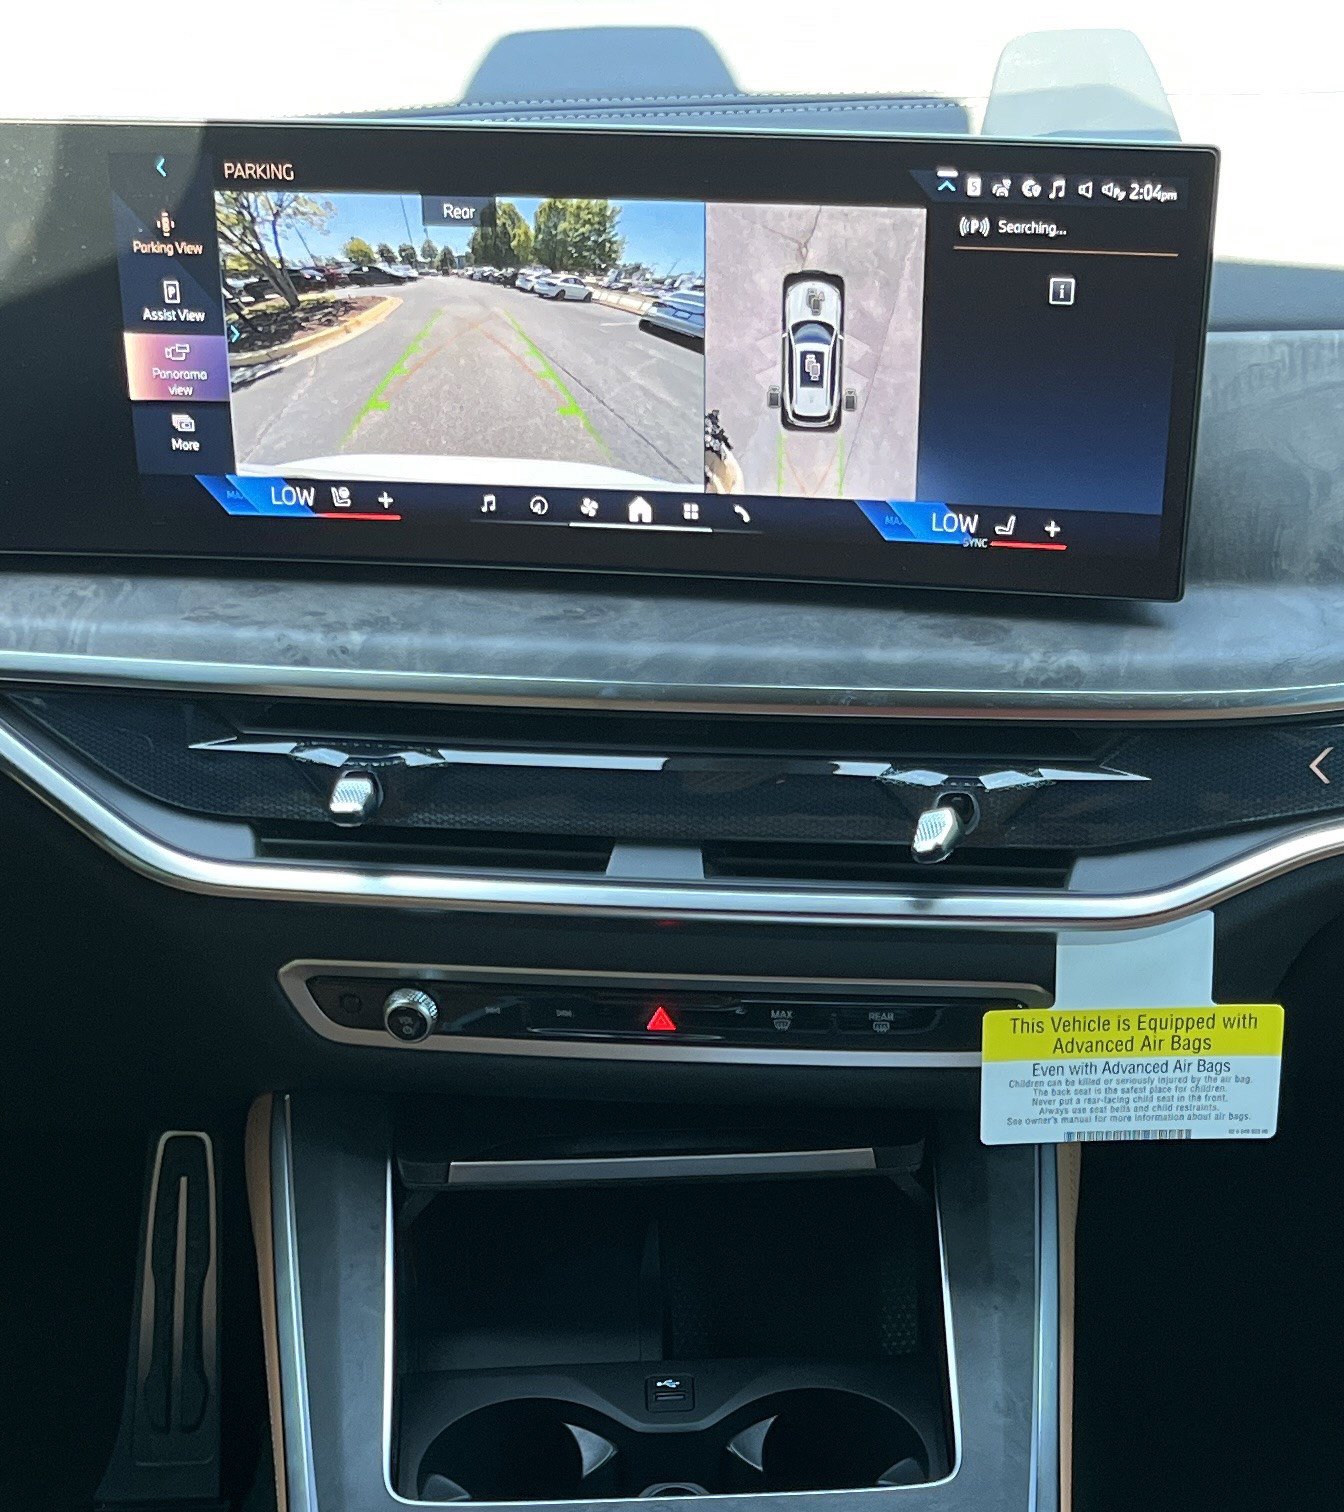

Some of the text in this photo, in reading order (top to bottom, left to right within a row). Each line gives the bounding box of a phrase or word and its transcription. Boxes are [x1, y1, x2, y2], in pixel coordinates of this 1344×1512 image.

[223, 162, 295, 181] PARKING
[1128, 182, 1178, 202] 2:04pm
[443, 203, 476, 219] Rear
[998, 219, 1067, 237] Searching...
[133, 240, 203, 257] Parking View
[143, 307, 206, 322] Assist View
[152, 367, 208, 381] Panorama
[168, 384, 193, 396] view
[171, 438, 200, 451] More
[271, 486, 315, 507] LOW
[931, 512, 979, 534] LOW
[962, 537, 988, 548] SYNC
[770, 1009, 794, 1019] MAX
[868, 1011, 895, 1021] REAR
[1010, 1012, 1258, 1034] This Vehicle is Equipped with
[1052, 1034, 1212, 1054] Advanced Air Bags
[1032, 1058, 1231, 1077] Even with Advanced Air Bags
[1009, 1079, 1044, 1088] Children
[1047, 1079, 1062, 1087] can
[1065, 1078, 1075, 1086] be
[1116, 1076, 1155, 1085] seriously
[1157, 1075, 1188, 1084] injured
[1191, 1075, 1201, 1084] by
[1204, 1075, 1217, 1083] the
[1220, 1075, 1231, 1083] air
[1033, 1088, 1048, 1096] The
[1051, 1088, 1071, 1096] back
[1074, 1087, 1092, 1095] seat
[1104, 1086, 1118, 1095] the
[1120, 1086, 1147, 1095] safest
[1149, 1085, 1171, 1094] place
[1175, 1084, 1187, 1093] for
[1032, 1098, 1056, 1106] Never
[1059, 1098, 1073, 1106] put
[1084, 1096, 1130, 1105] rear-facing
[1133, 1094, 1154, 1103] child
[1156, 1094, 1174, 1102] seat
[1188, 1094, 1202, 1102] the
[1039, 1107, 1069, 1116] Always
[1110, 1105, 1131, 1113] belts
[1152, 1104, 1173, 1112] child
[1007, 1117, 1022, 1126] See
[1061, 1115, 1091, 1123] manual
[1134, 1112, 1184, 1121] information
[1187, 1112, 1212, 1120] about
[1214, 1112, 1226, 1120] air
